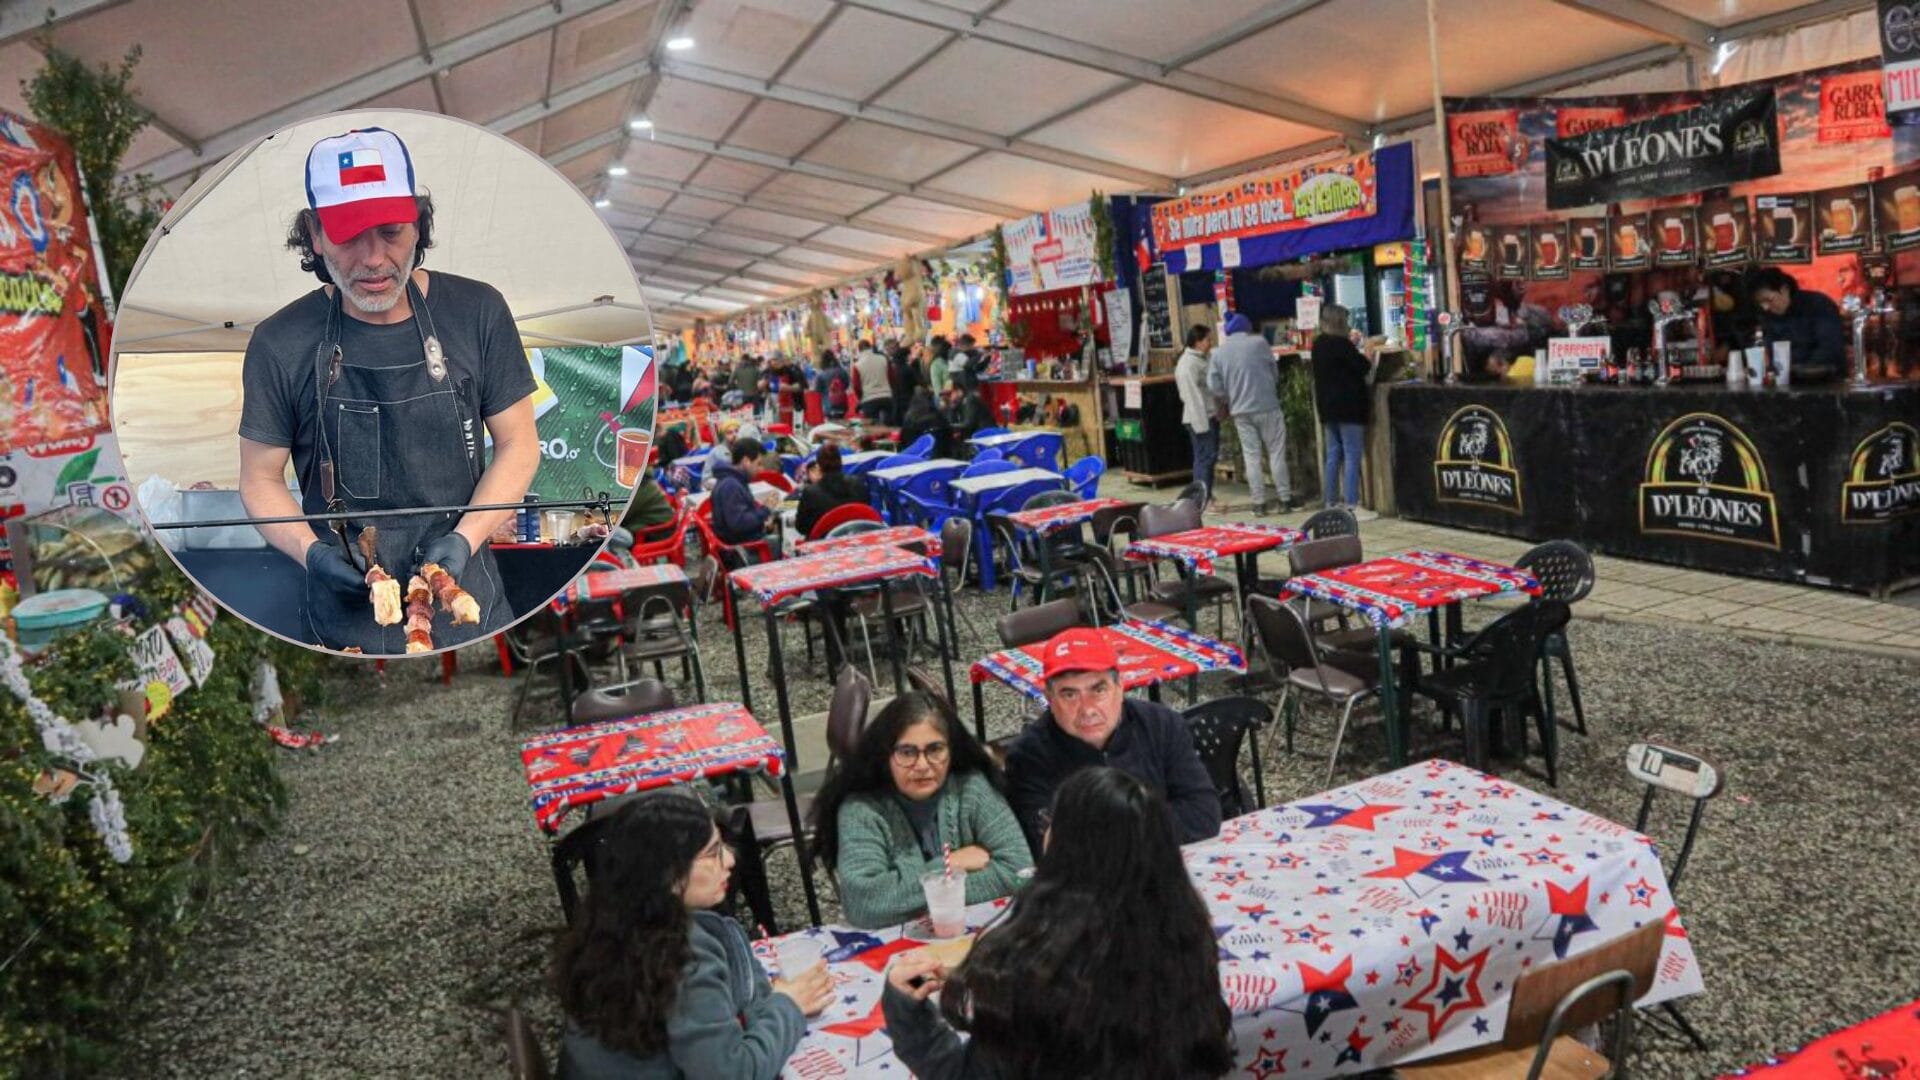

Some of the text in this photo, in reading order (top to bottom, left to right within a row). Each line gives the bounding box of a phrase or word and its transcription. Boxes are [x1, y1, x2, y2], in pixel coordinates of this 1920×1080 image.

[1829, 84, 1884, 104] GARRA
[1833, 99, 1880, 121] RUBIA
[1458, 120, 1510, 141] GARRA
[1442, 471, 1513, 496] D'LEONES
[1651, 494, 1762, 526] D'LEONES
